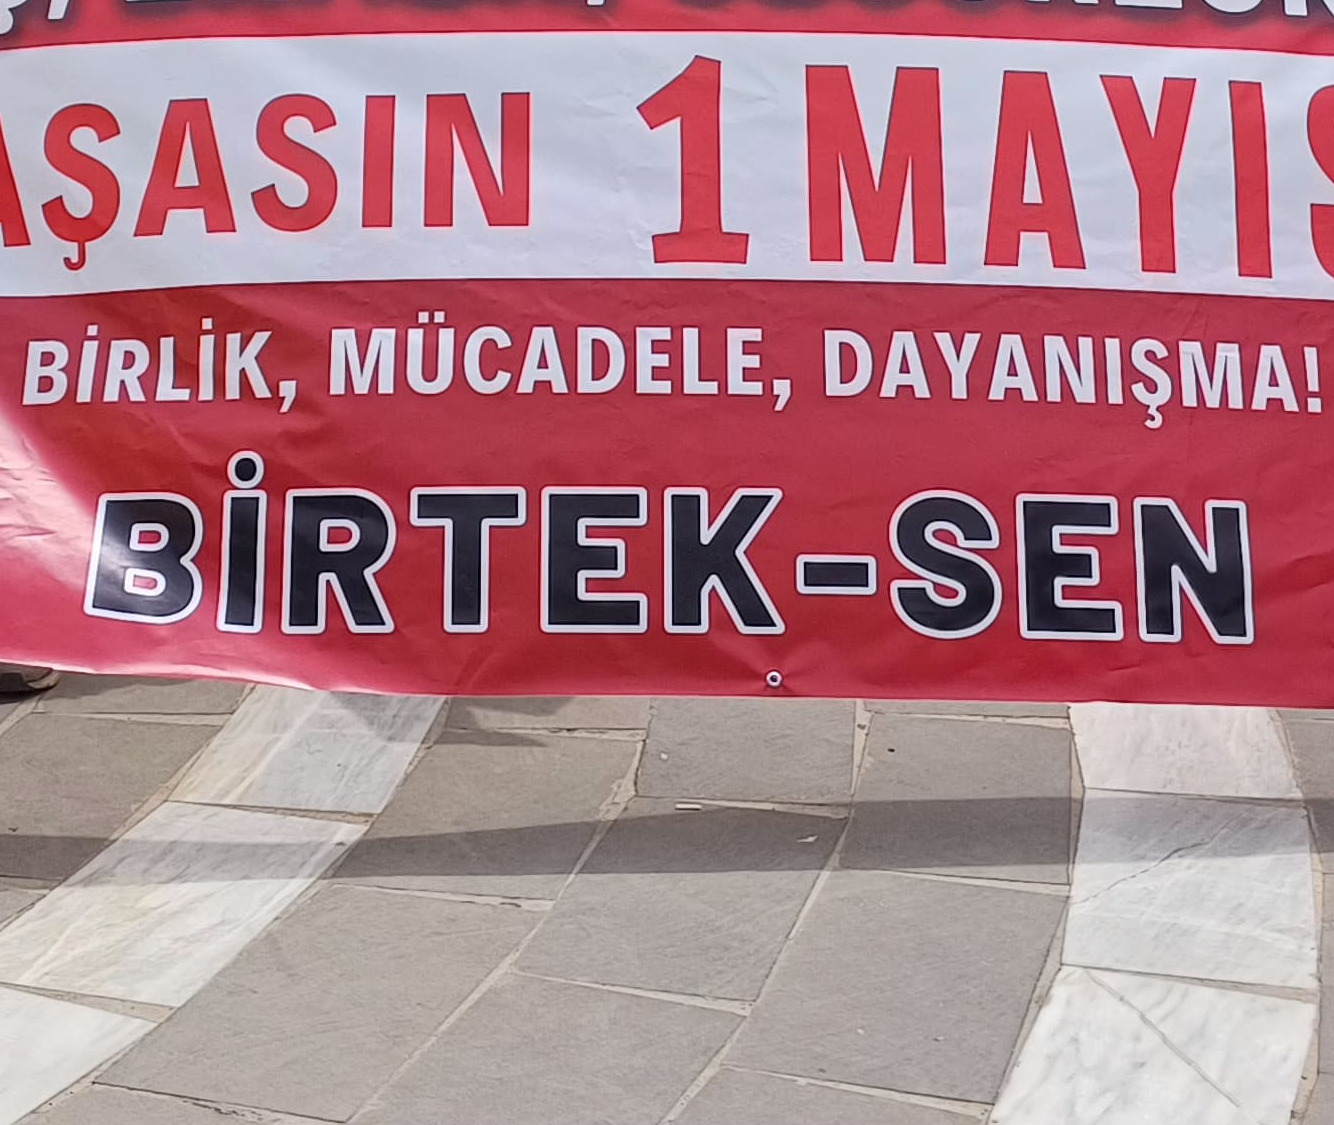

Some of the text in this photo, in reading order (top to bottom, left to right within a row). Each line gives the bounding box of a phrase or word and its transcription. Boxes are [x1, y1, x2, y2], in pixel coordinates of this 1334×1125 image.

[636, 54, 749, 265] 1
[22, 311, 1323, 429] BİRLİK, MÜCADELE, DAYANIŞMA!
[83, 450, 1255, 645] BİRTEK-SEN
